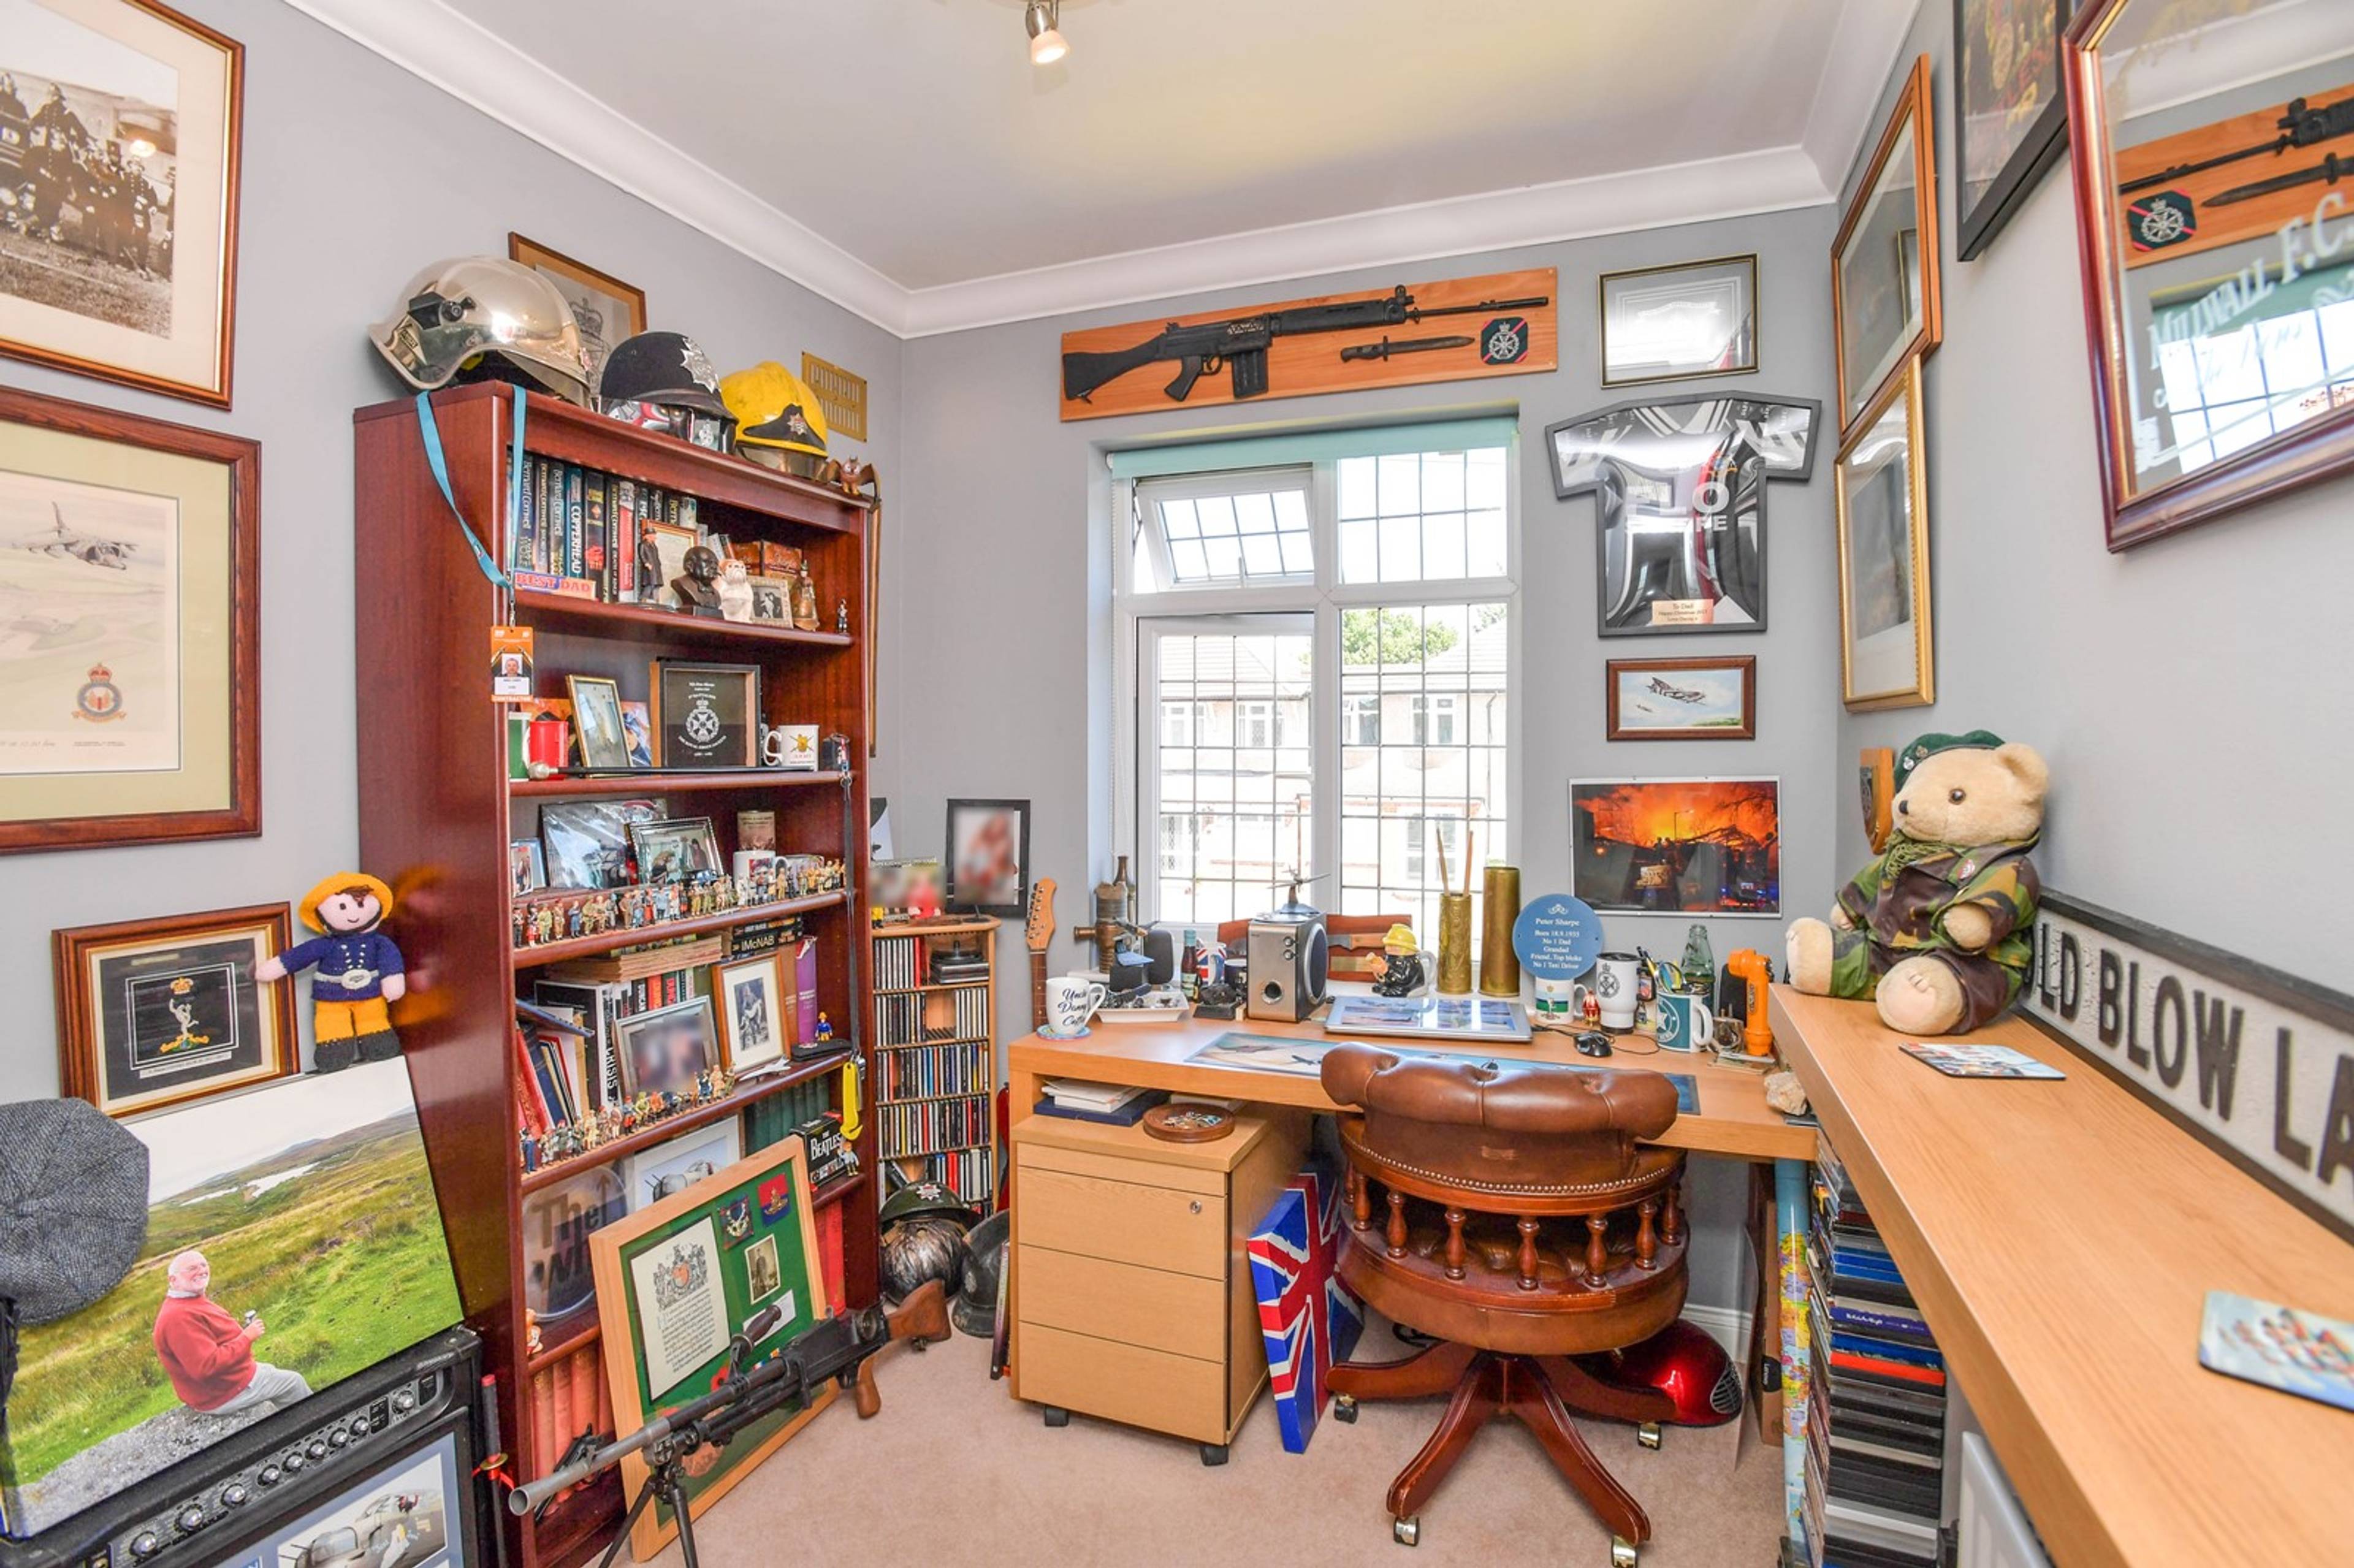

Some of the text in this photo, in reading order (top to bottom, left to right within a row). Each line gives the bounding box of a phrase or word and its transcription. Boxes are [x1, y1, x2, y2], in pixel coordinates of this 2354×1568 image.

[571, 506, 582, 574] COPPERHEAD
[516, 573, 591, 592] BEST DAD
[2098, 948, 2245, 1122] BLOW
[810, 1133, 844, 1161] BEATLES
[1762, 1363, 1770, 1385] Lenovo
